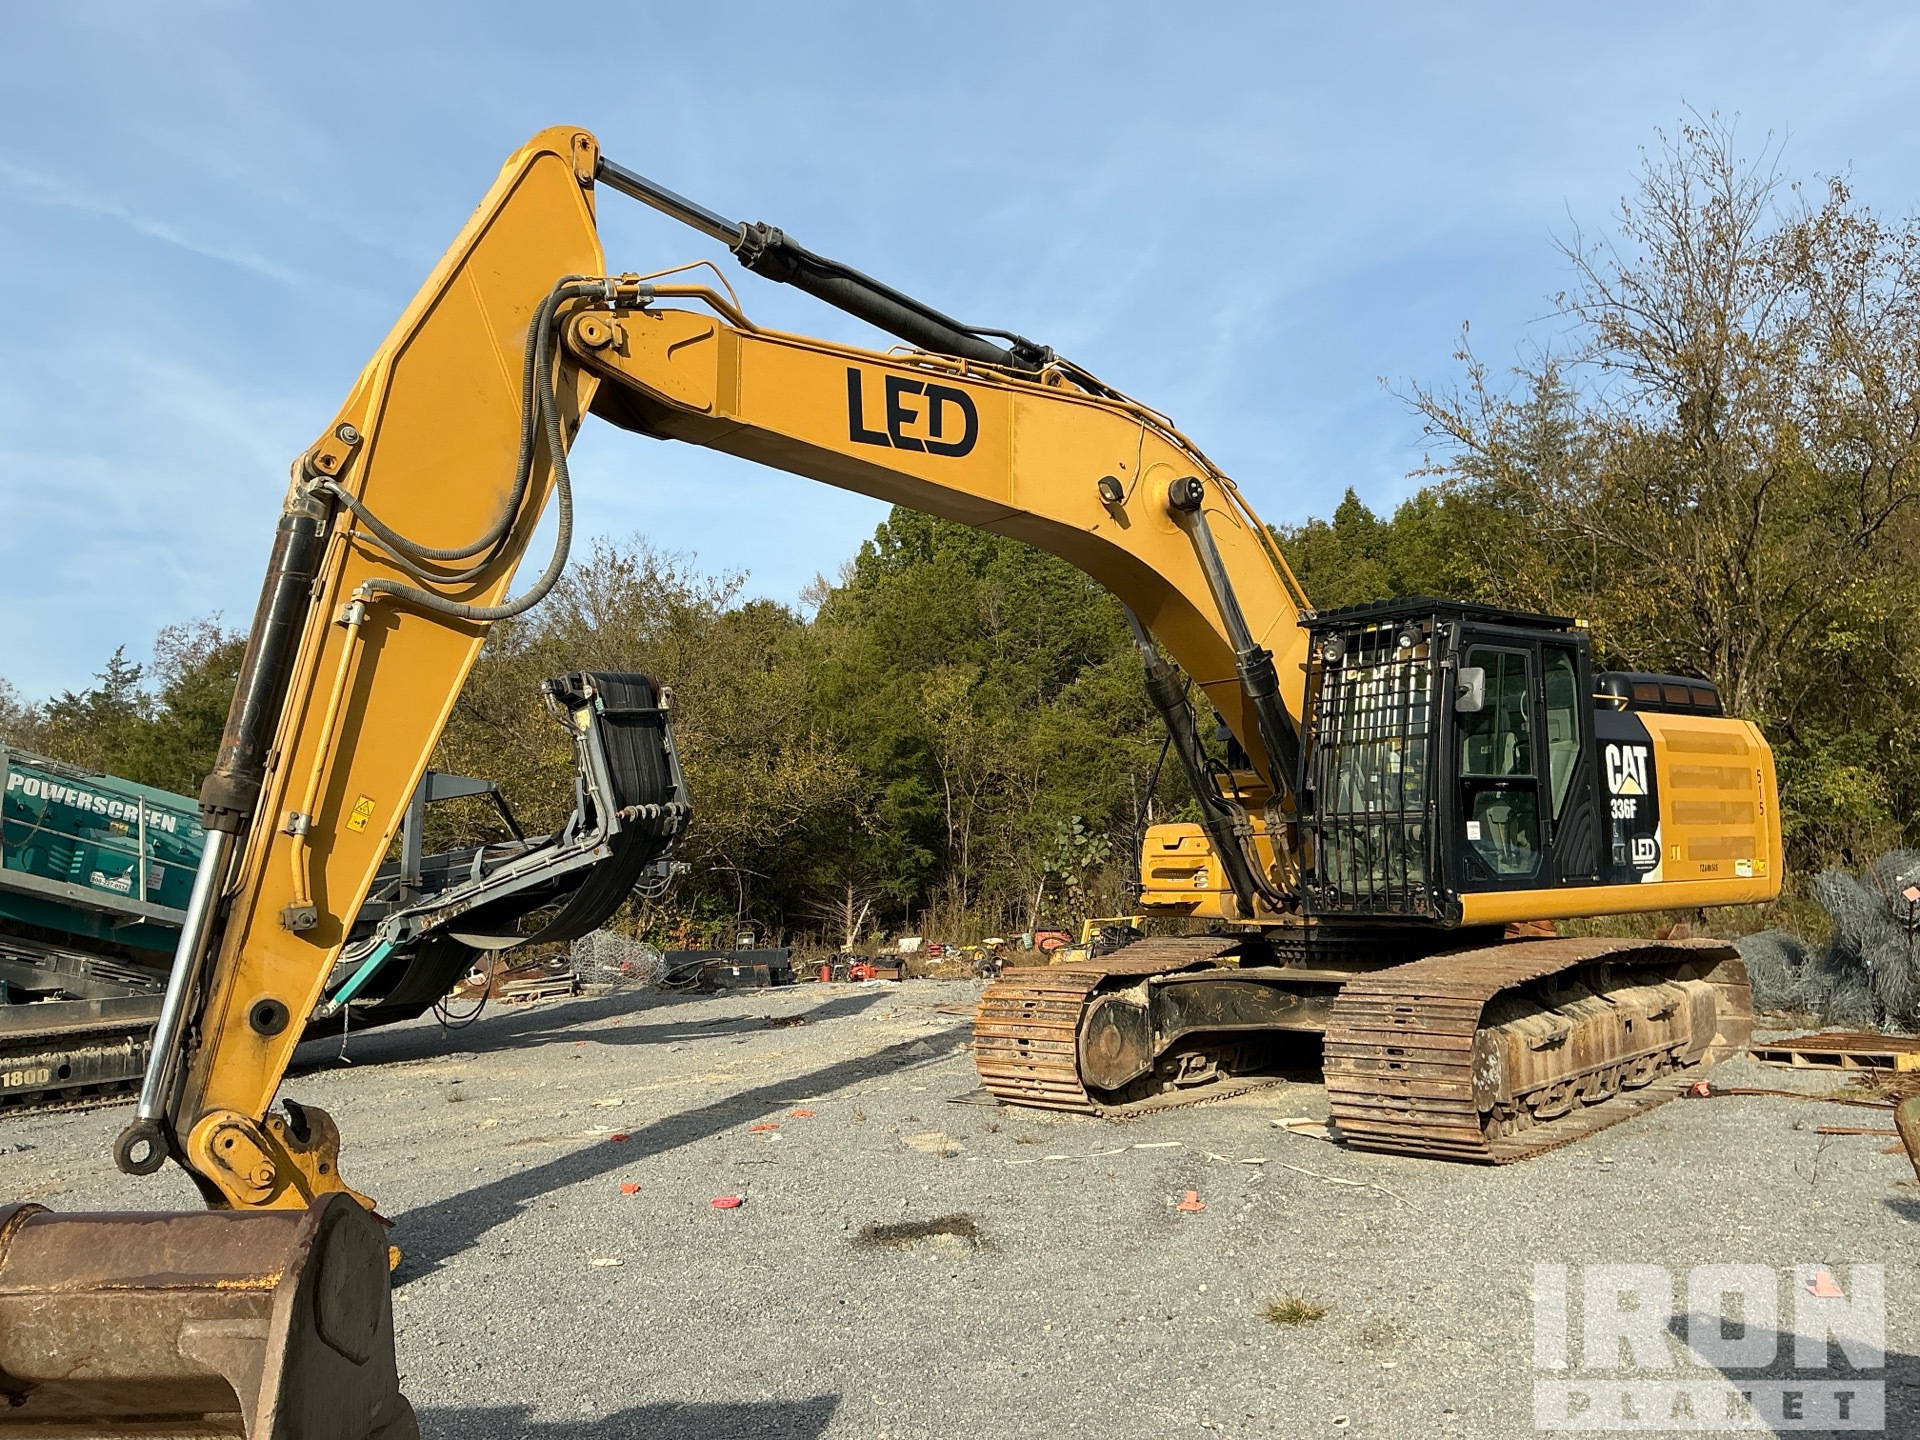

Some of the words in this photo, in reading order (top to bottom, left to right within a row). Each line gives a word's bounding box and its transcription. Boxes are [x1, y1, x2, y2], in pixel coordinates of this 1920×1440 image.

[847, 367, 978, 457] LED
[1605, 743, 1648, 795] CAT
[1610, 798, 1637, 819] 336F
[1631, 838, 1656, 861] LED
[0, 1068, 50, 1088] 1800
